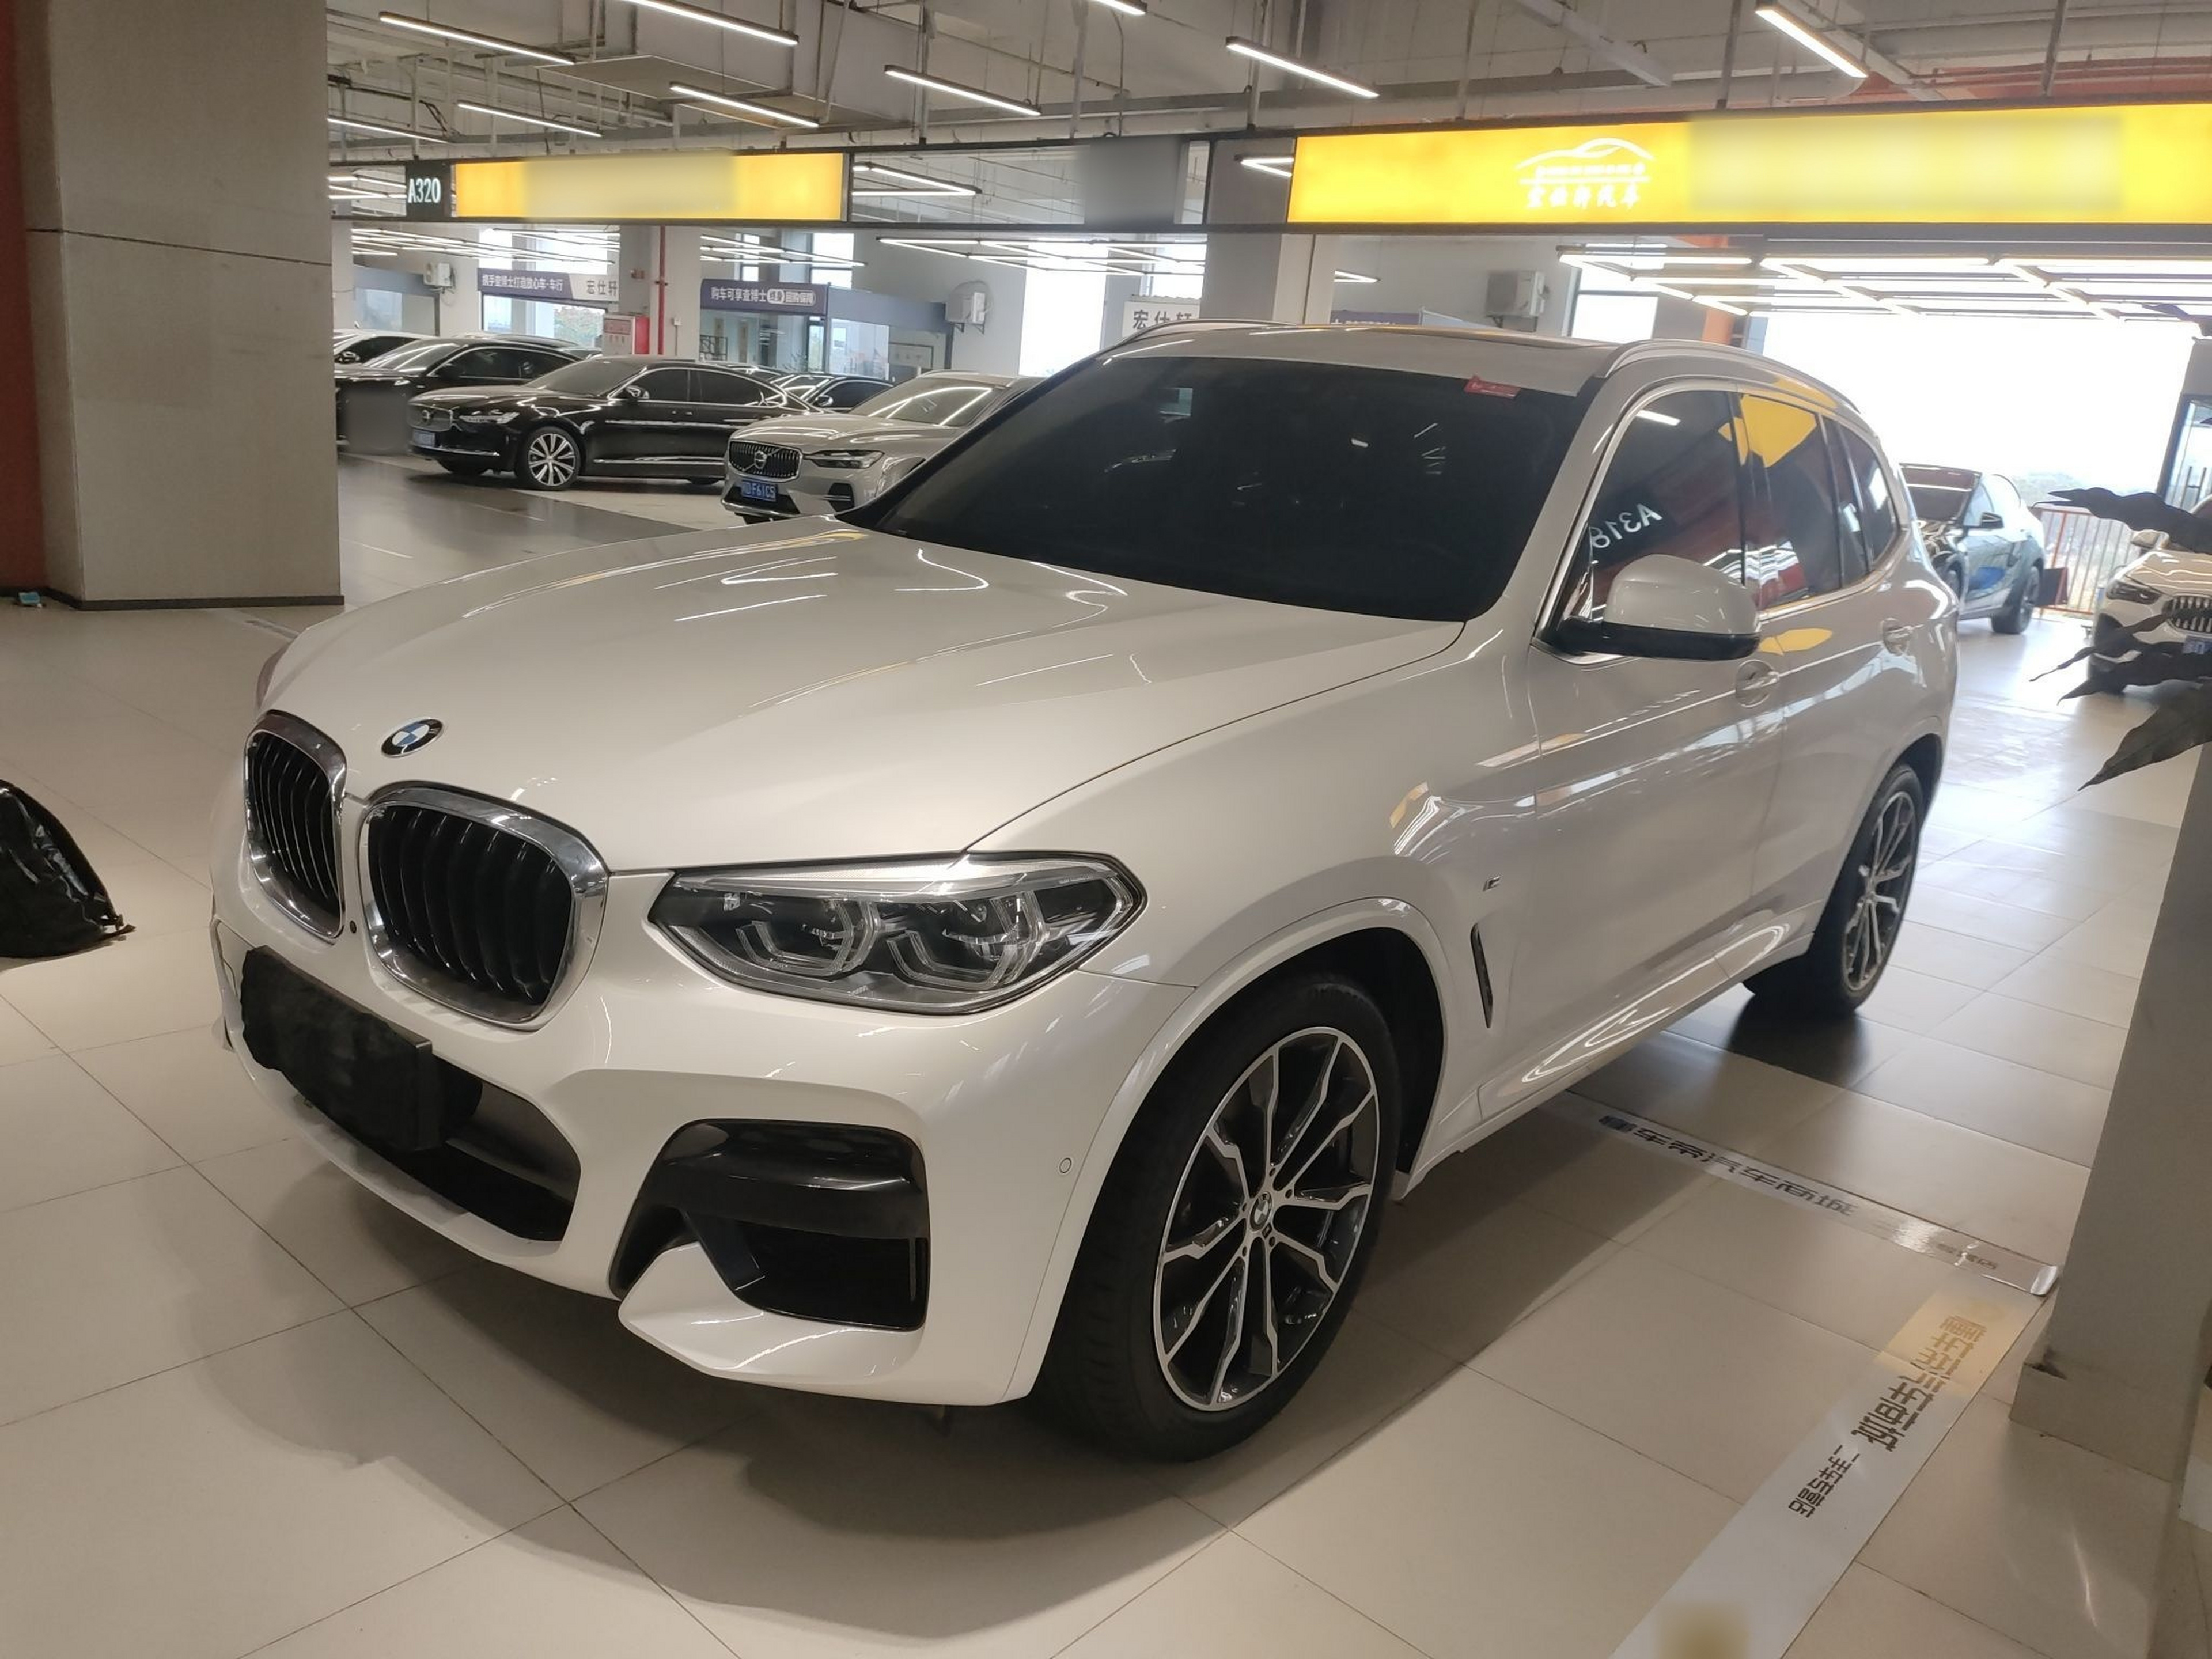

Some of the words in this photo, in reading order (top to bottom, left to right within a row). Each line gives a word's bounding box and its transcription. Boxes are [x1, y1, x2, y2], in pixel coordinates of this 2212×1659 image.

[408, 177, 441, 203] A320
[1789, 1445, 1861, 1518] 二手车专营店
